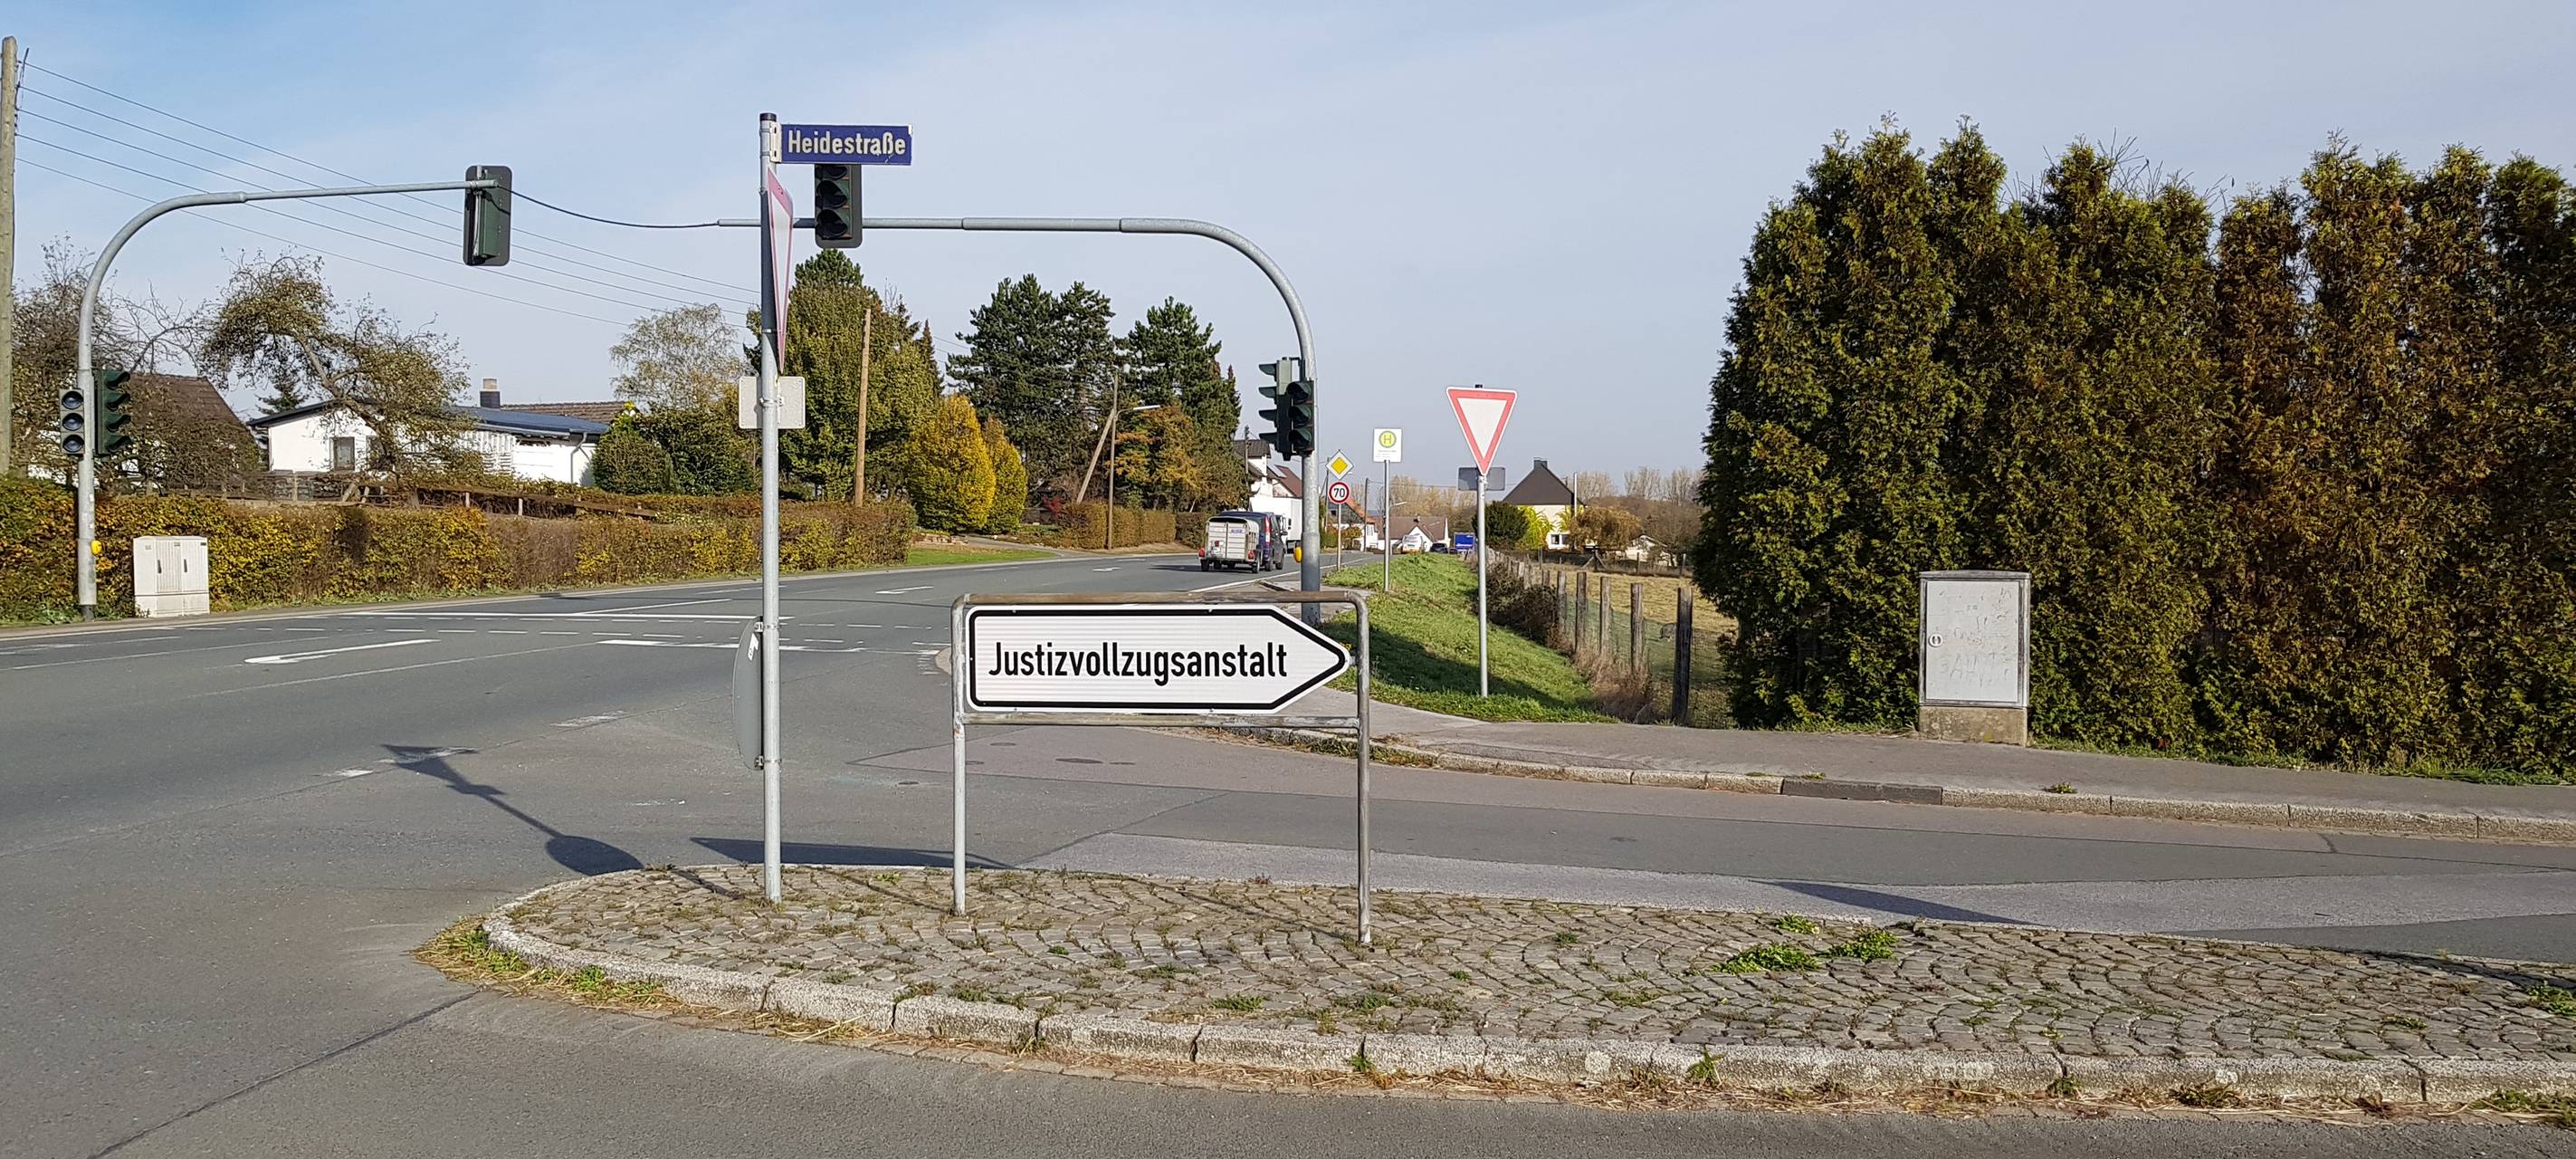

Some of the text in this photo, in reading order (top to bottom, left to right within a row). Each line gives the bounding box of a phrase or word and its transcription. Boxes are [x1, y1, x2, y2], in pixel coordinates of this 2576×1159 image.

[787, 129, 906, 155] Heidestraße
[1383, 434, 1392, 445] H
[1333, 487, 1346, 498] 70
[988, 641, 1287, 686] Justizvollzugsanstalt
